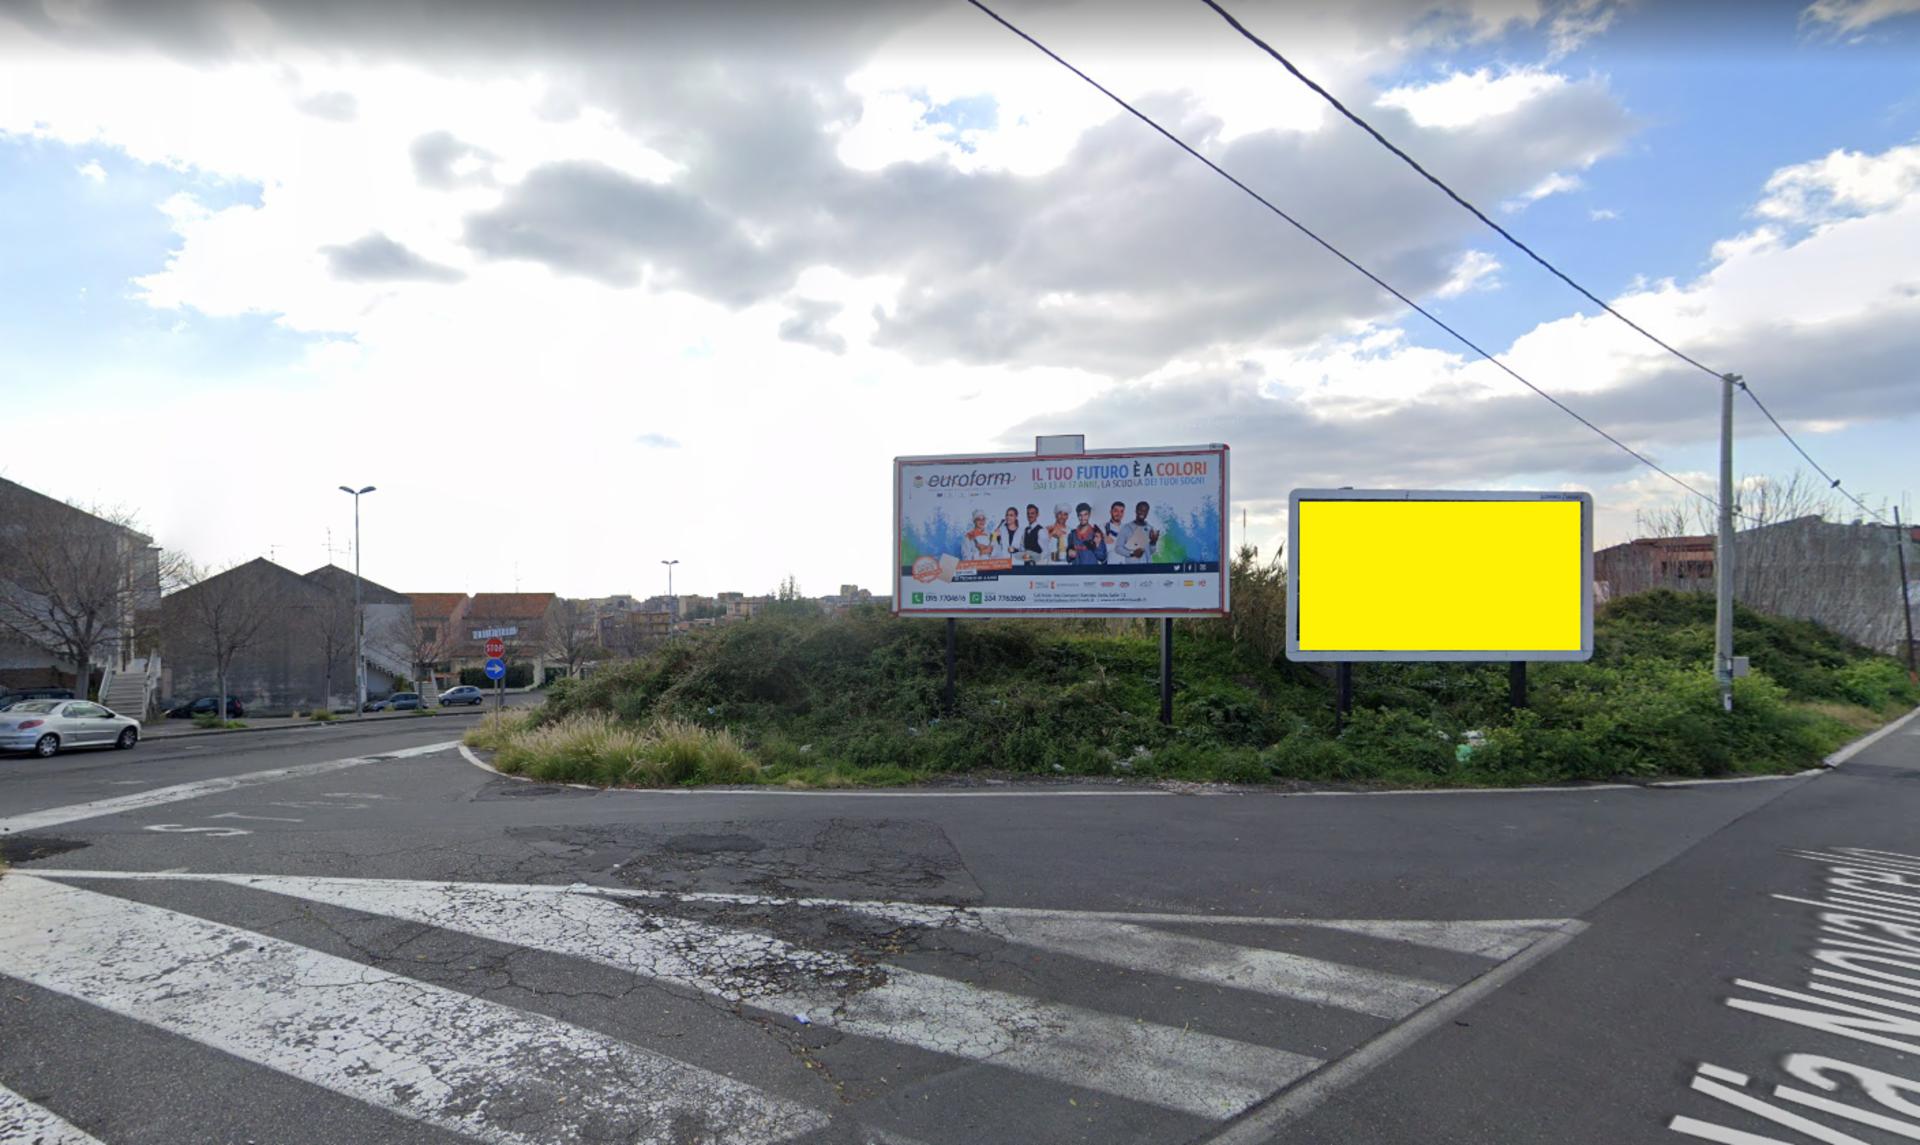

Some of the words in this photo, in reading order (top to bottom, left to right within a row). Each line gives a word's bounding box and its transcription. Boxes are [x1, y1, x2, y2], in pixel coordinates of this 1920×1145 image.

[1032, 467, 1043, 481] IL
[1046, 466, 1073, 481] TUO
[1076, 464, 1129, 480] FUTURO
[1133, 460, 1140, 477] È
[1144, 463, 1153, 477] A
[1156, 461, 1207, 477] COLORI
[927, 470, 1016, 487] euroform
[1101, 479, 1111, 489] LA
[1112, 478, 1143, 488] SCUOLA
[1144, 478, 1158, 487] DEI
[1160, 477, 1179, 487] TUOI
[1180, 476, 1205, 486] SOGNI
[486, 644, 505, 652] STOP
